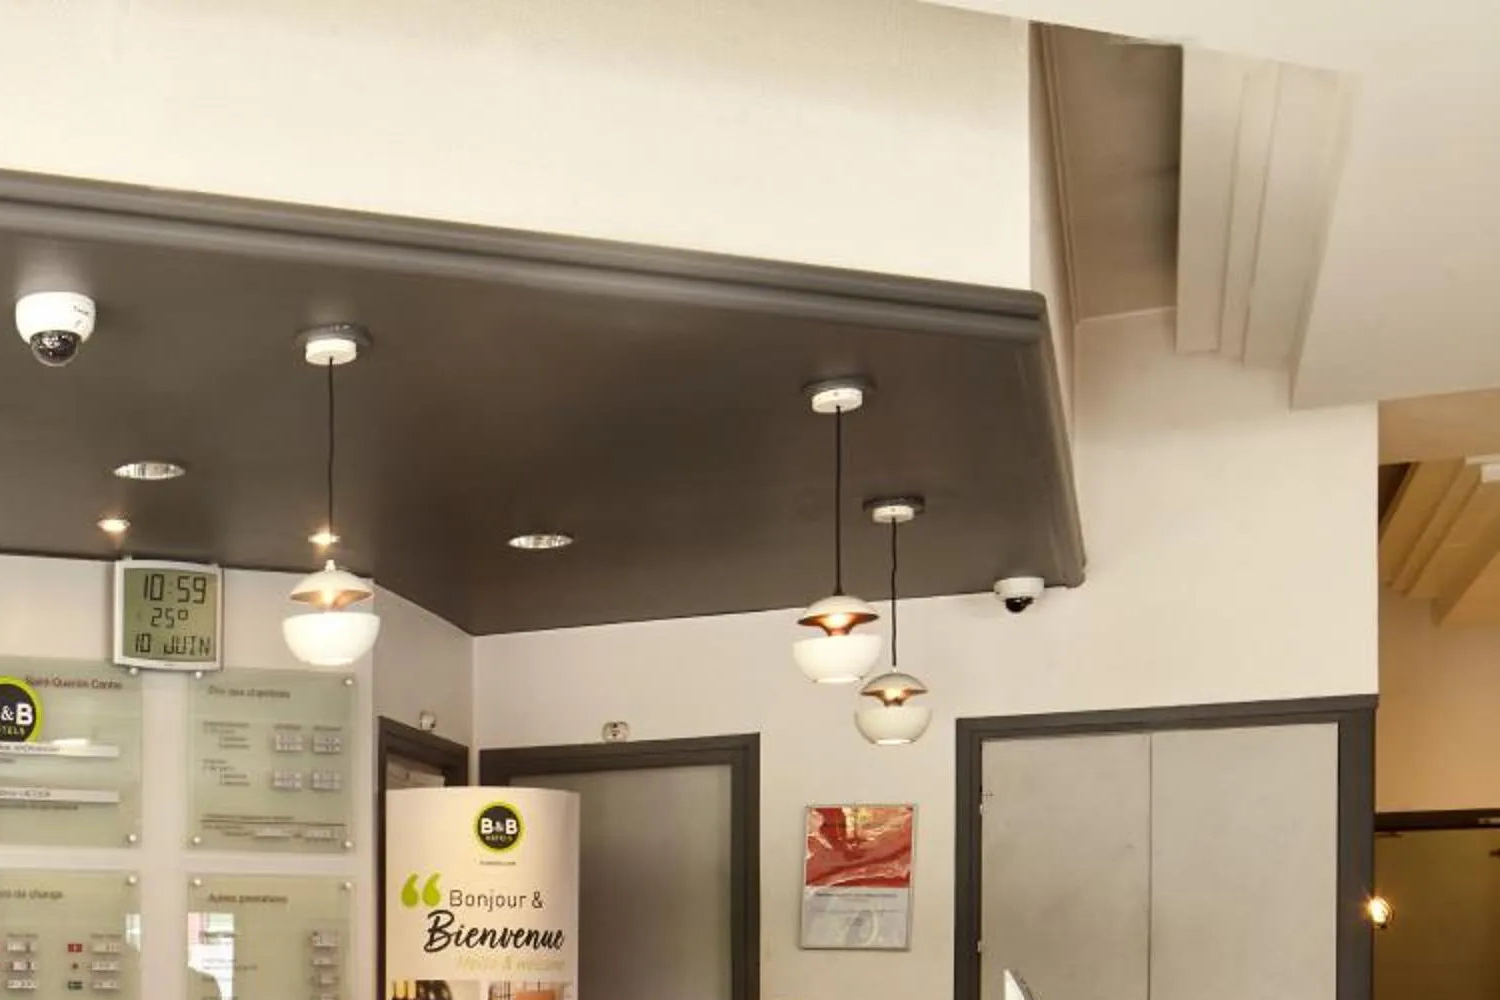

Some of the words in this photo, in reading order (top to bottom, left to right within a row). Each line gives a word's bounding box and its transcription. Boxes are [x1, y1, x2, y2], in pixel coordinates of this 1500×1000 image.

[135, 633, 151, 653] 10
[163, 635, 211, 656] JUIN
[481, 818, 518, 835] B&B
[449, 889, 526, 912] Bonjour
[531, 890, 544, 909] &
[423, 909, 565, 953] Bienvenue
